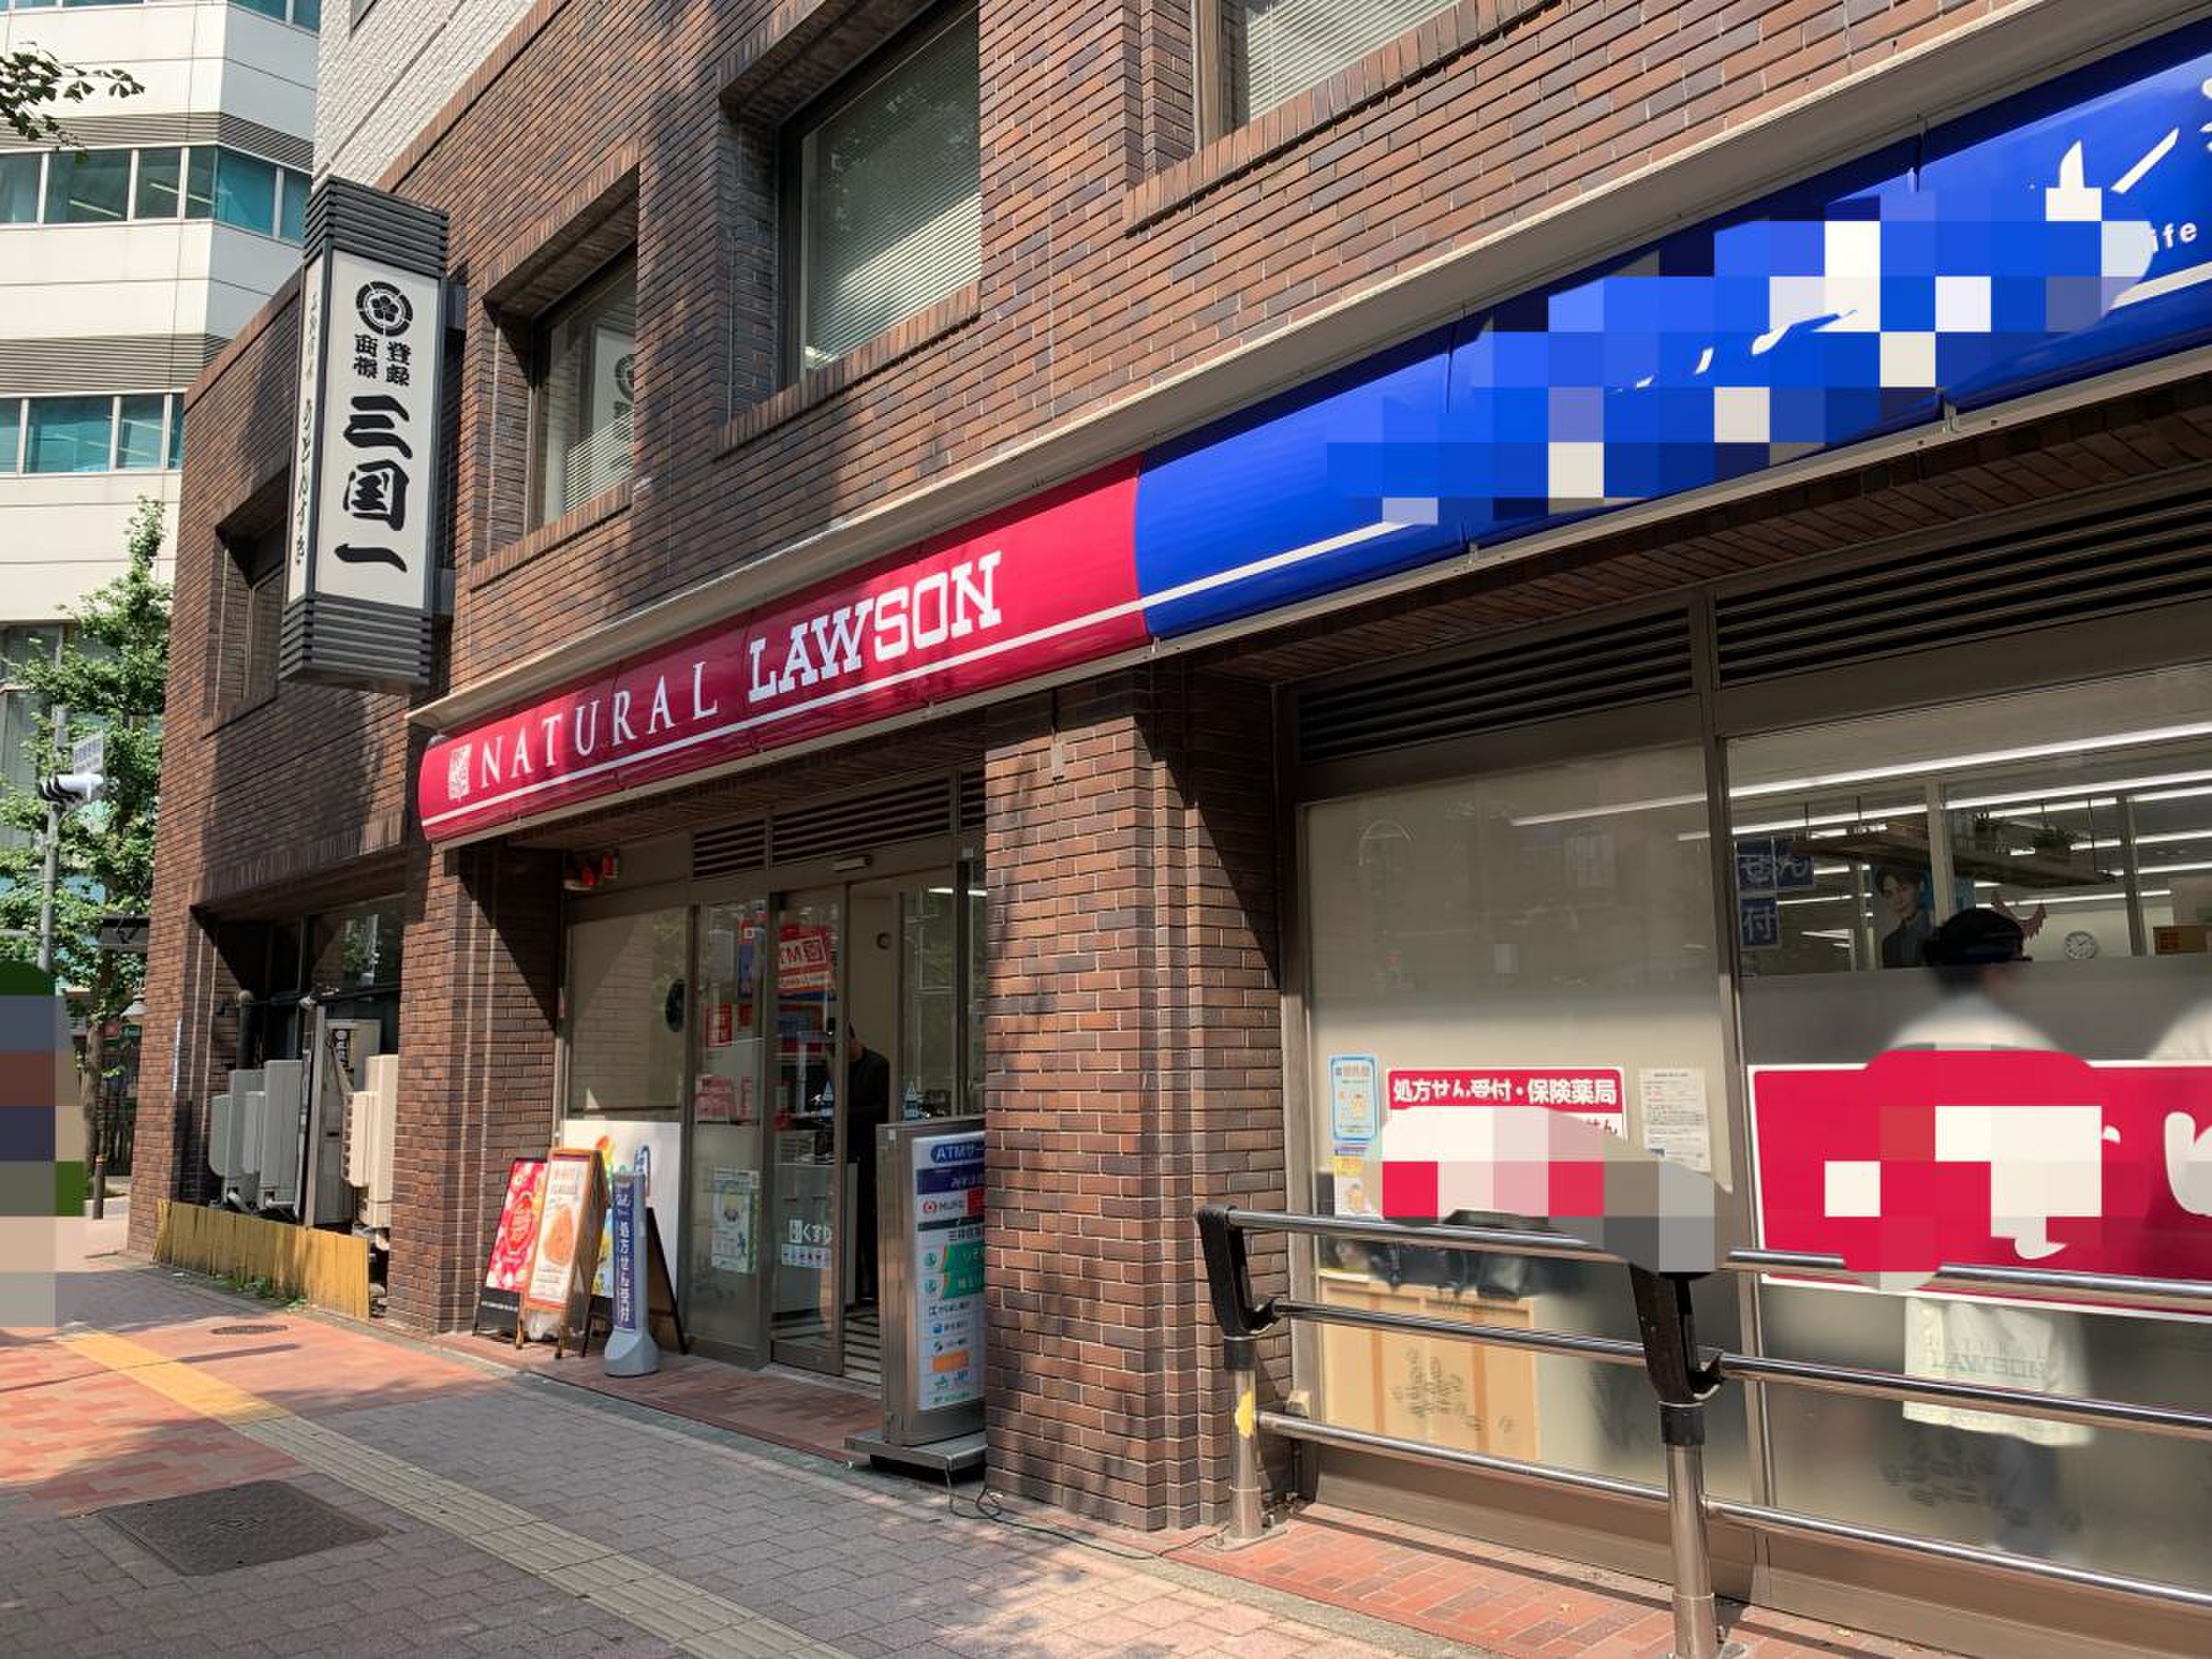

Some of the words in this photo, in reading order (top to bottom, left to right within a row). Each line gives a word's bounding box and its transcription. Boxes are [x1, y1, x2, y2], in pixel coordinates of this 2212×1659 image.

[335, 394, 414, 573] 三国一
[480, 662, 718, 789] NATURAL
[748, 550, 1003, 700] LAWSON
[1393, 1078, 1618, 1105] 処方せん受付・保険薬局
